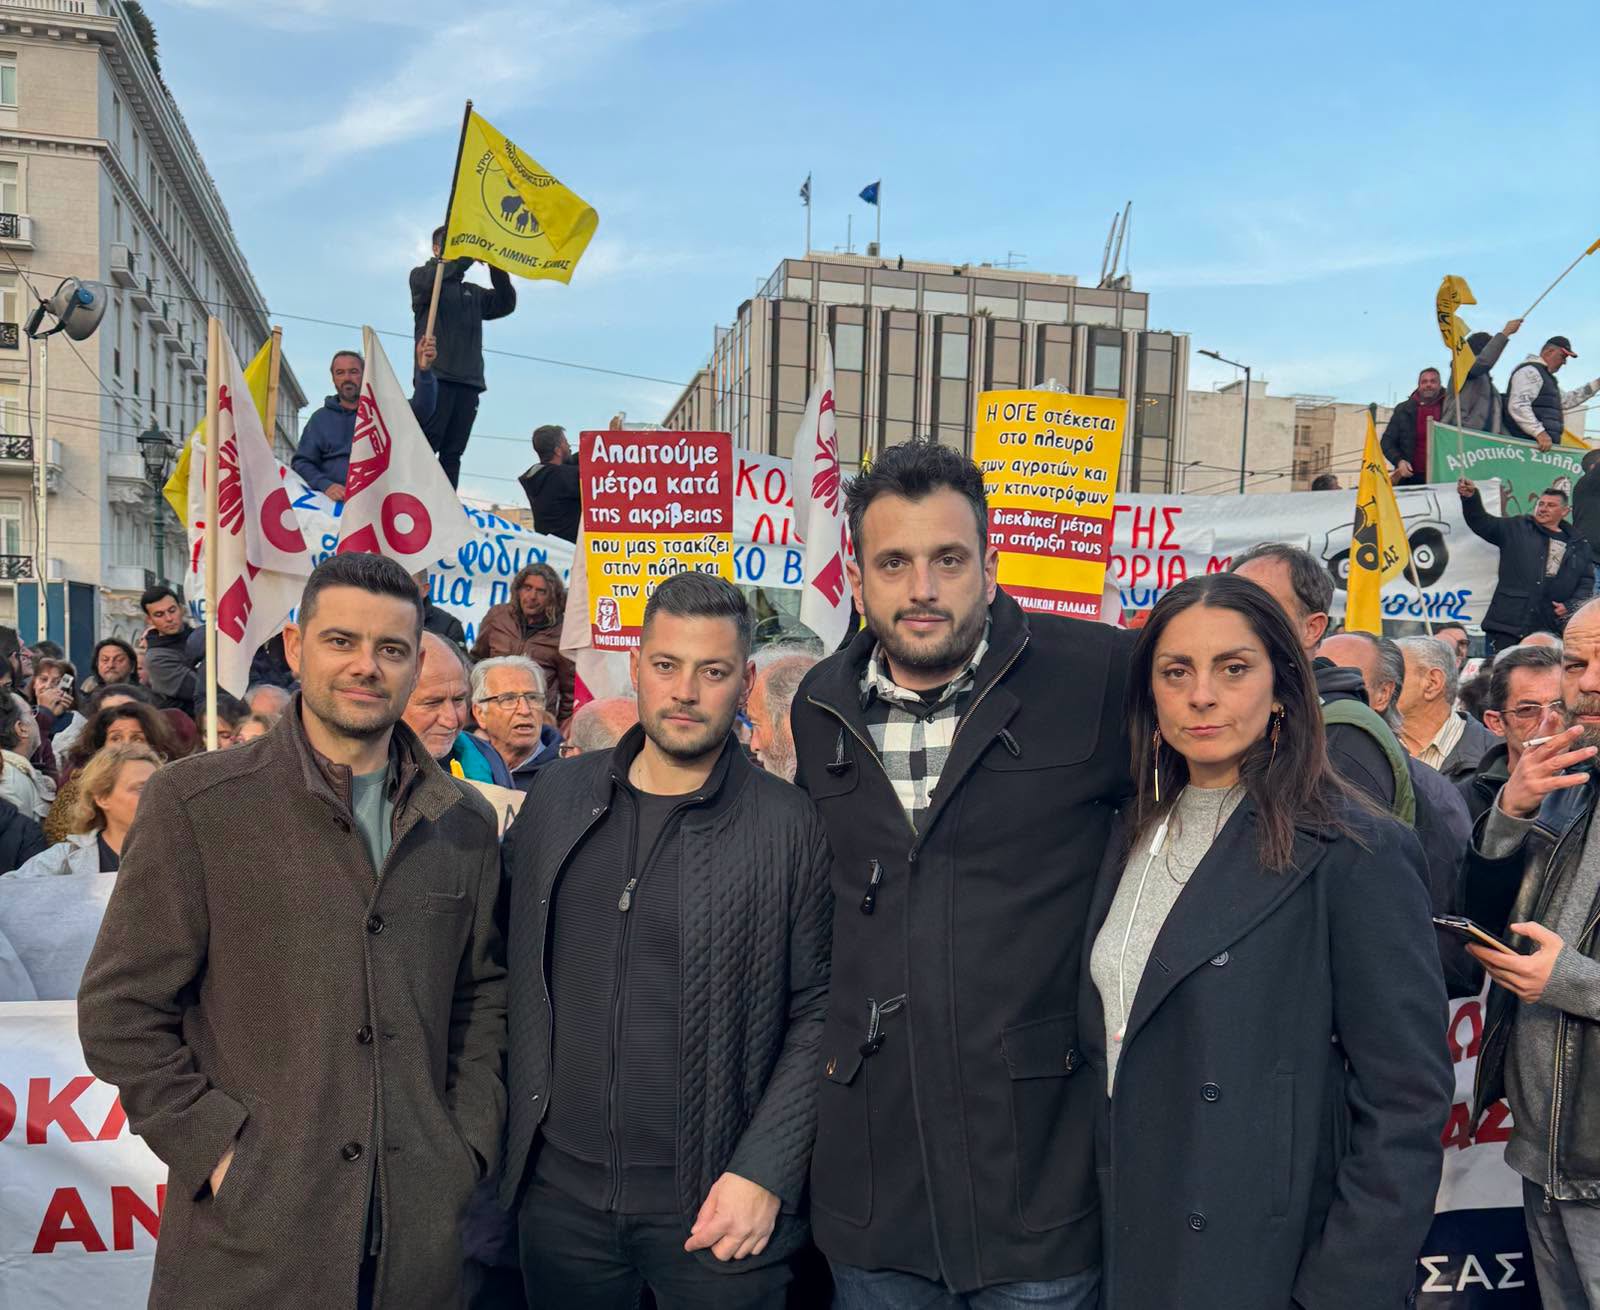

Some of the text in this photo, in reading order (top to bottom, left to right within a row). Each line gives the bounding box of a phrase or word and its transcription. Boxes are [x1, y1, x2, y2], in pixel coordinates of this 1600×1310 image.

[987, 403, 1116, 431] Η ΟΓΕ στέκεται
[591, 435, 719, 470] Απαιτούμε
[1000, 429, 1093, 454] στο πλευρό
[1446, 444, 1525, 471] Αγροτικός
[980, 459, 1107, 482] των αγροτών και
[591, 470, 720, 500] μέτρα κατά
[1004, 482, 1109, 506] κτηνοτρόφων
[590, 502, 723, 529] της ακρίβειας
[993, 508, 1103, 535] διεκδικεί μέτρα
[592, 535, 729, 559] που μας τσακίζει
[990, 531, 1102, 555] τη στήριξη τους
[603, 558, 719, 575] στην πόλη και
[612, 585, 639, 597] την
[1057, 601, 1097, 615] ΕΛΛΑΔΑΣ
[1420, 1252, 1525, 1292] ΣΑΣ
